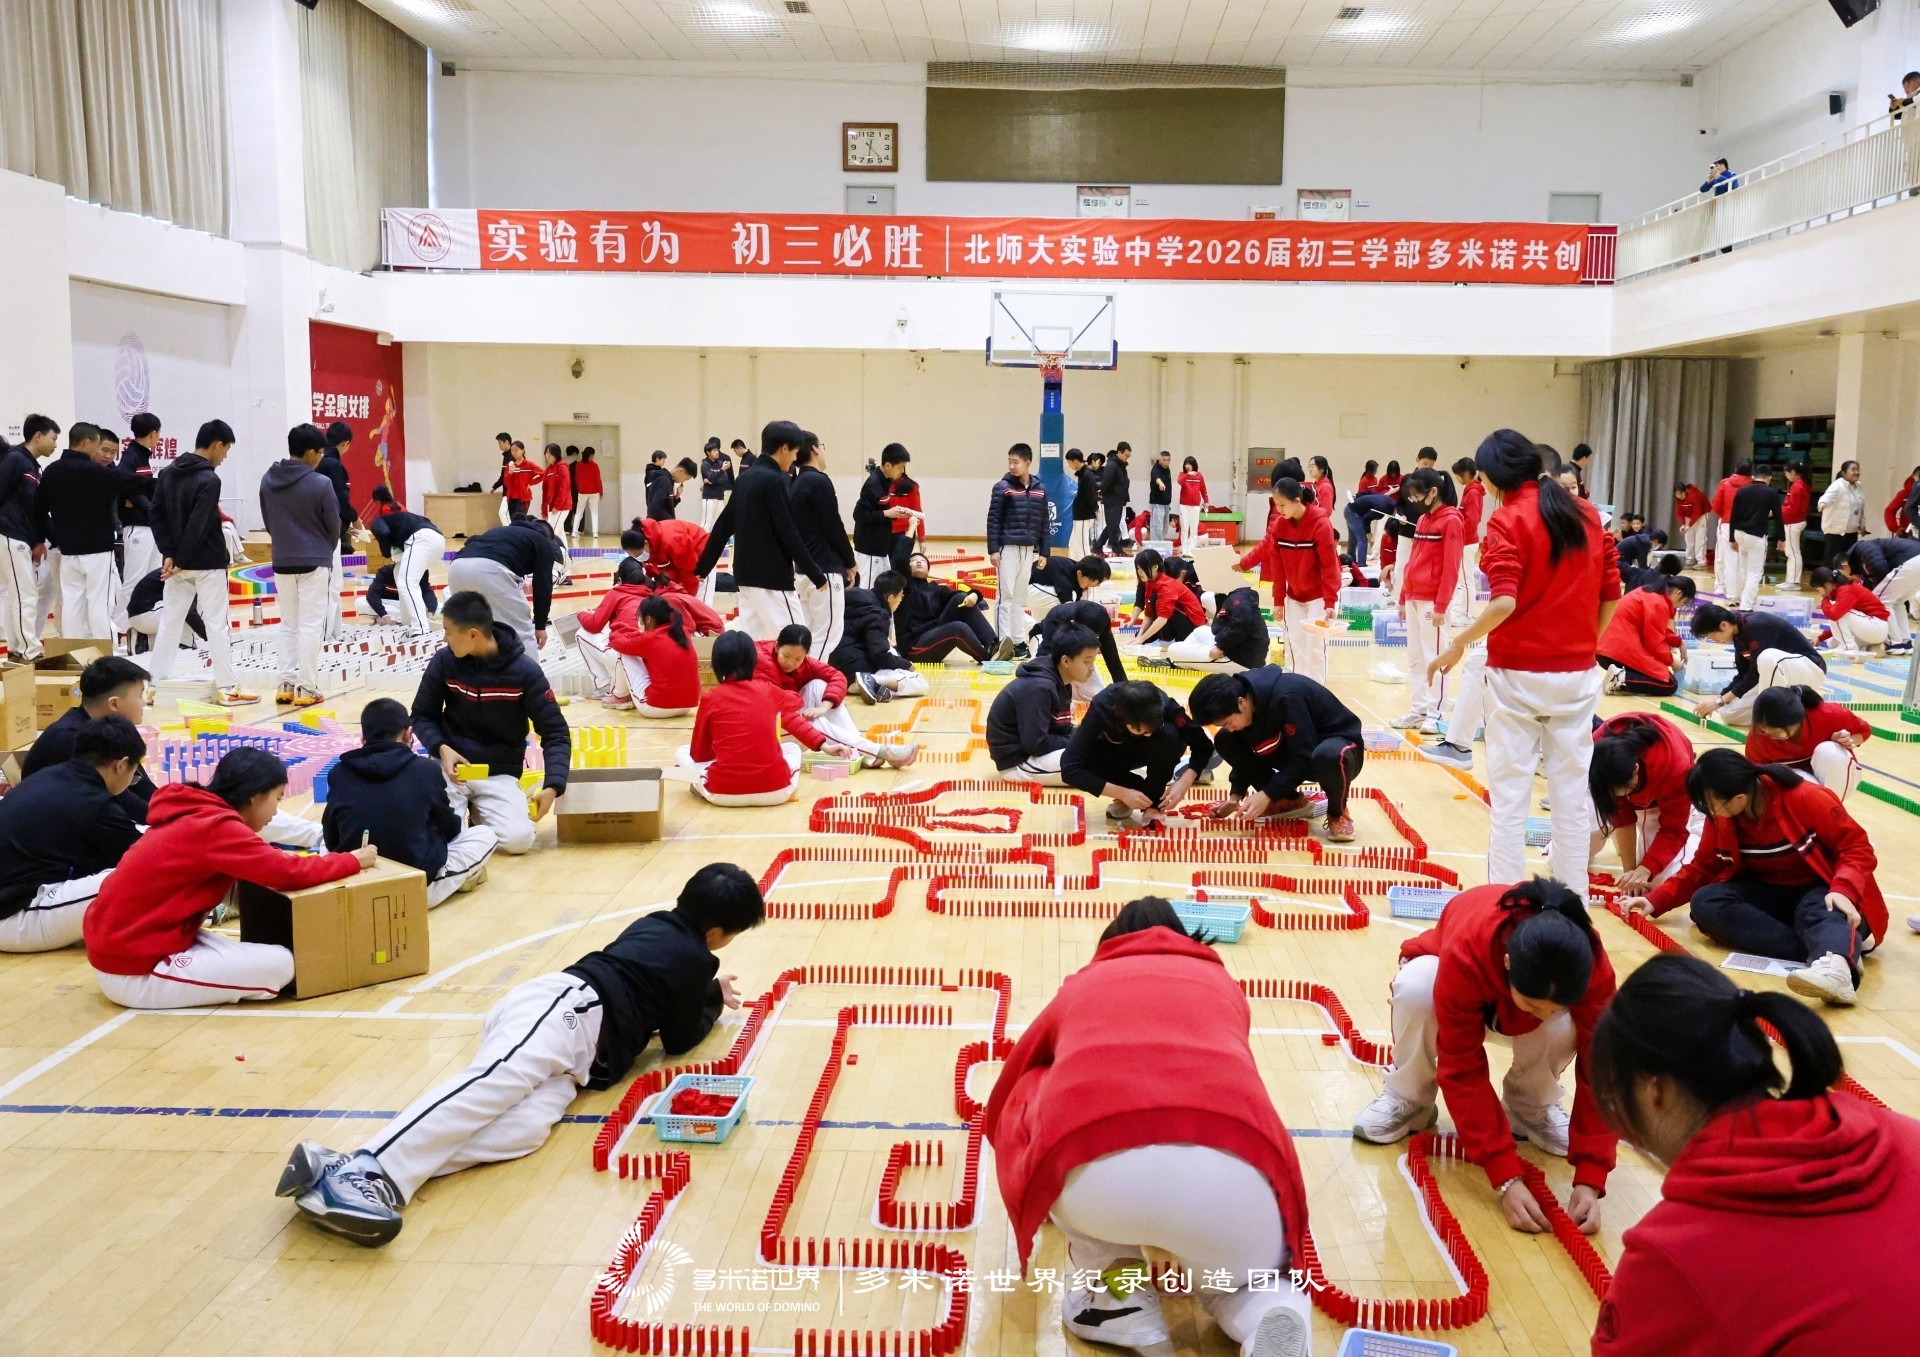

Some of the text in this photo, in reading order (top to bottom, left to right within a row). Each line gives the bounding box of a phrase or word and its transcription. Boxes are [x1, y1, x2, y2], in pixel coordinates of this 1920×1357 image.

[487, 219, 680, 265] 实验有为
[731, 222, 924, 269] 初三必胜
[963, 233, 1582, 272] 北师大实验中学2026届初三学部多米诺共创
[312, 392, 370, 419] 学金奥女排
